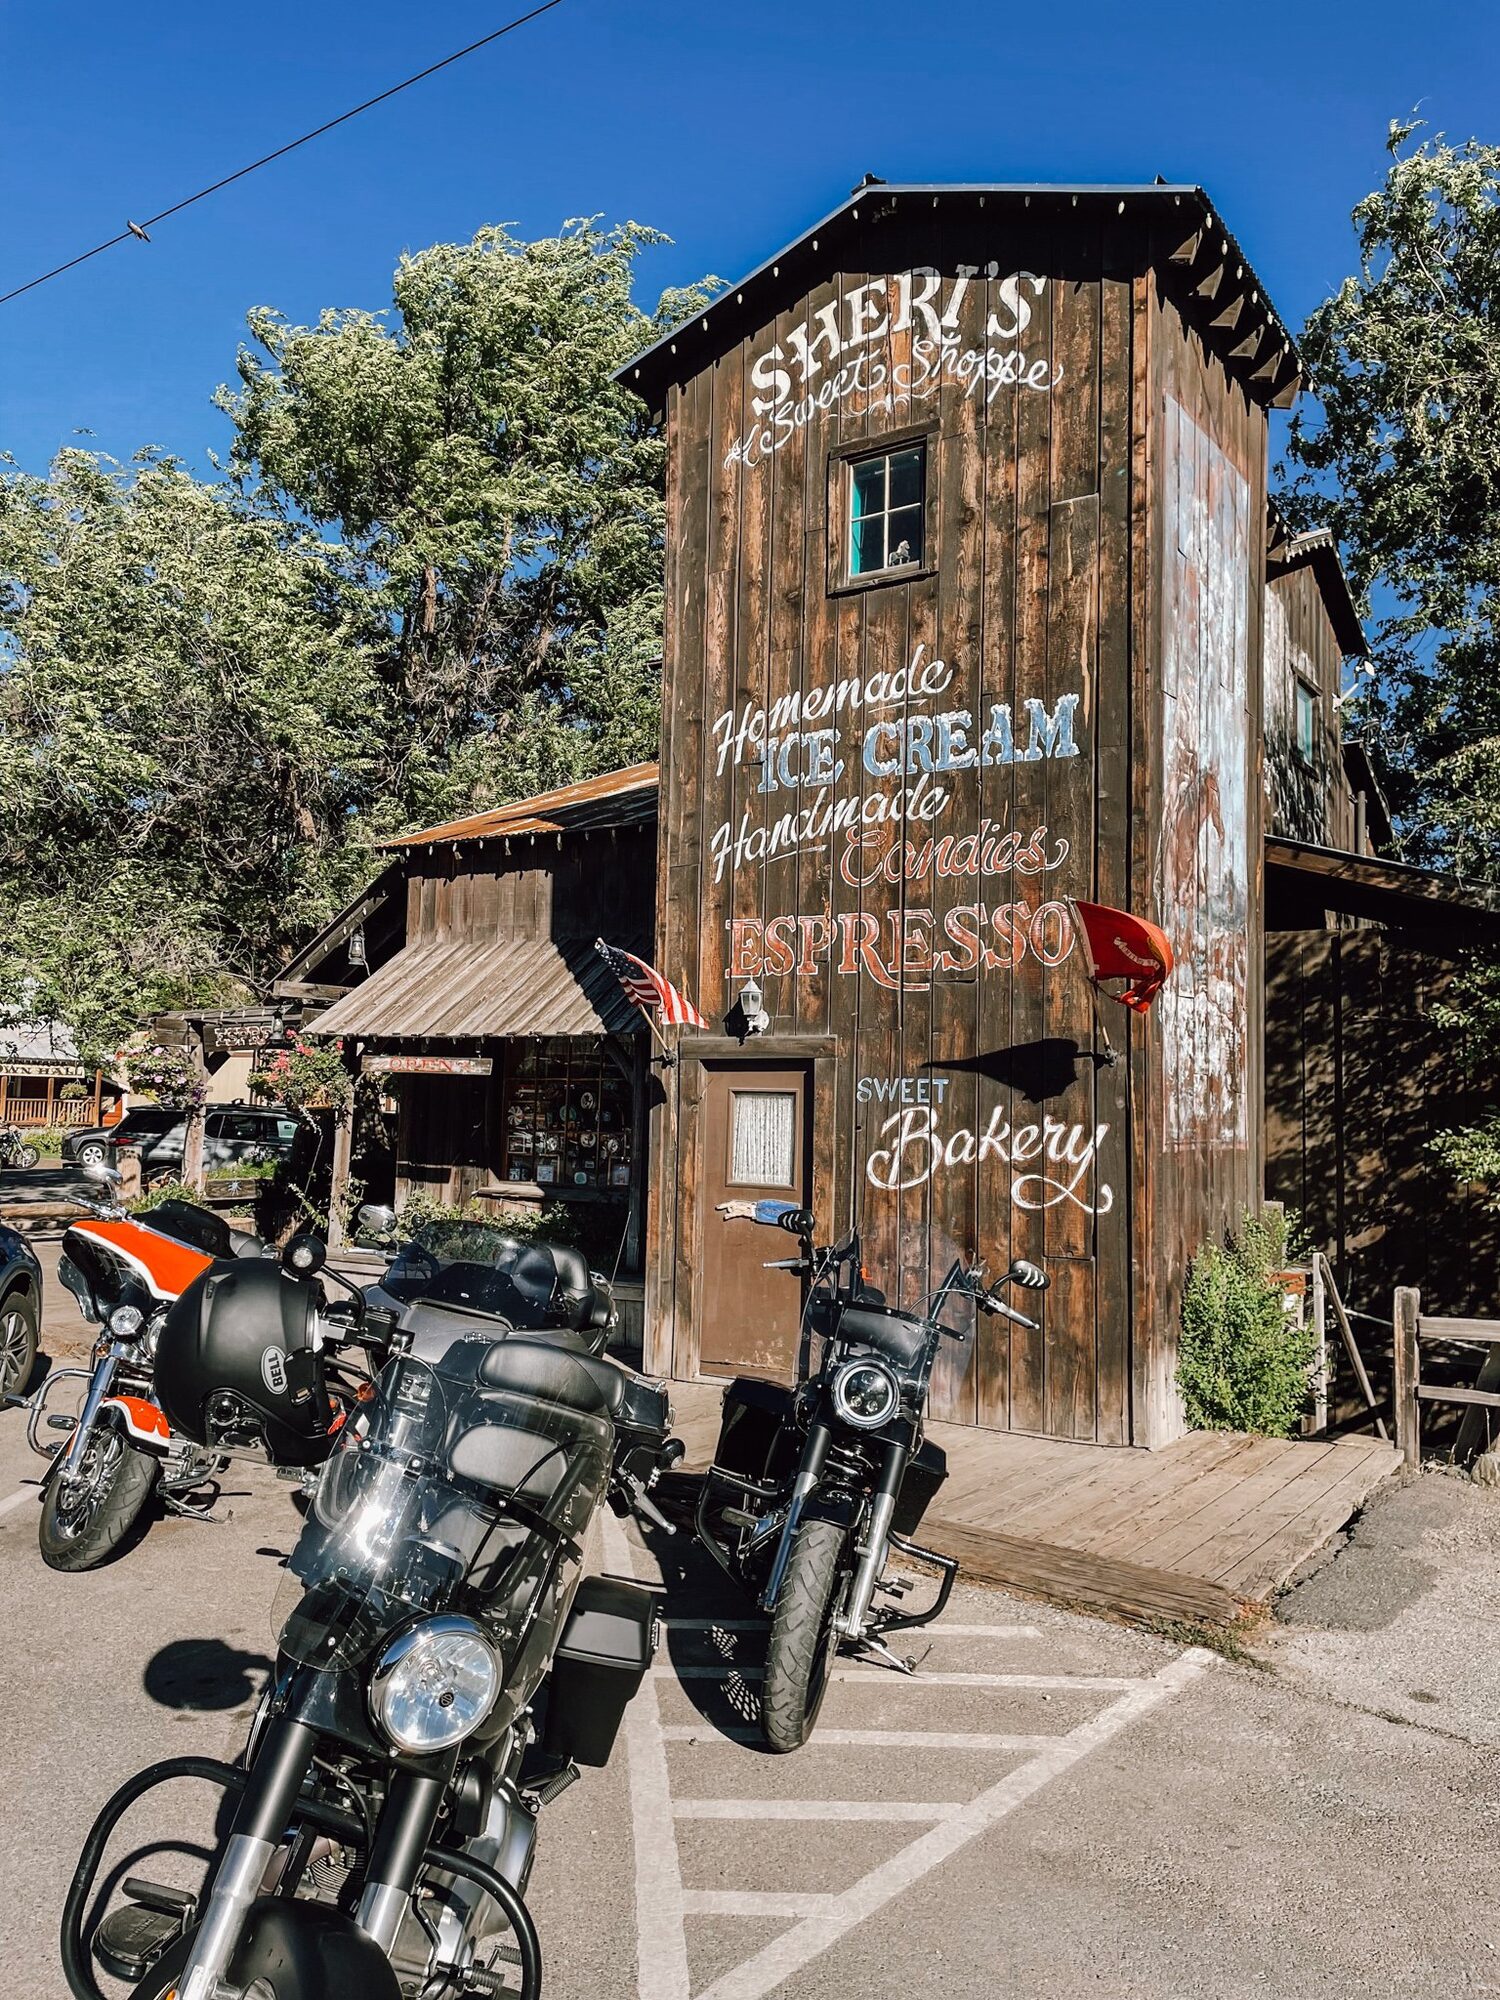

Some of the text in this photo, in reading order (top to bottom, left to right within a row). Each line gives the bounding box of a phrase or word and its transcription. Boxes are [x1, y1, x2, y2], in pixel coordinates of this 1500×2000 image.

[751, 261, 1047, 416] SHERI'S
[760, 332, 1063, 454] Sweet Shoppe
[712, 644, 953, 776] Homemade
[756, 693, 1080, 793] ICE CREAM
[711, 773, 950, 883] Handmade
[840, 819, 1069, 887] Candies
[725, 900, 1076, 991] ESPRESSO
[38, 1066, 83, 1077] HALL
[856, 1077, 949, 1104] SWEET
[867, 1105, 1113, 1214] Bakery
[268, 1353, 284, 1388] BELL
